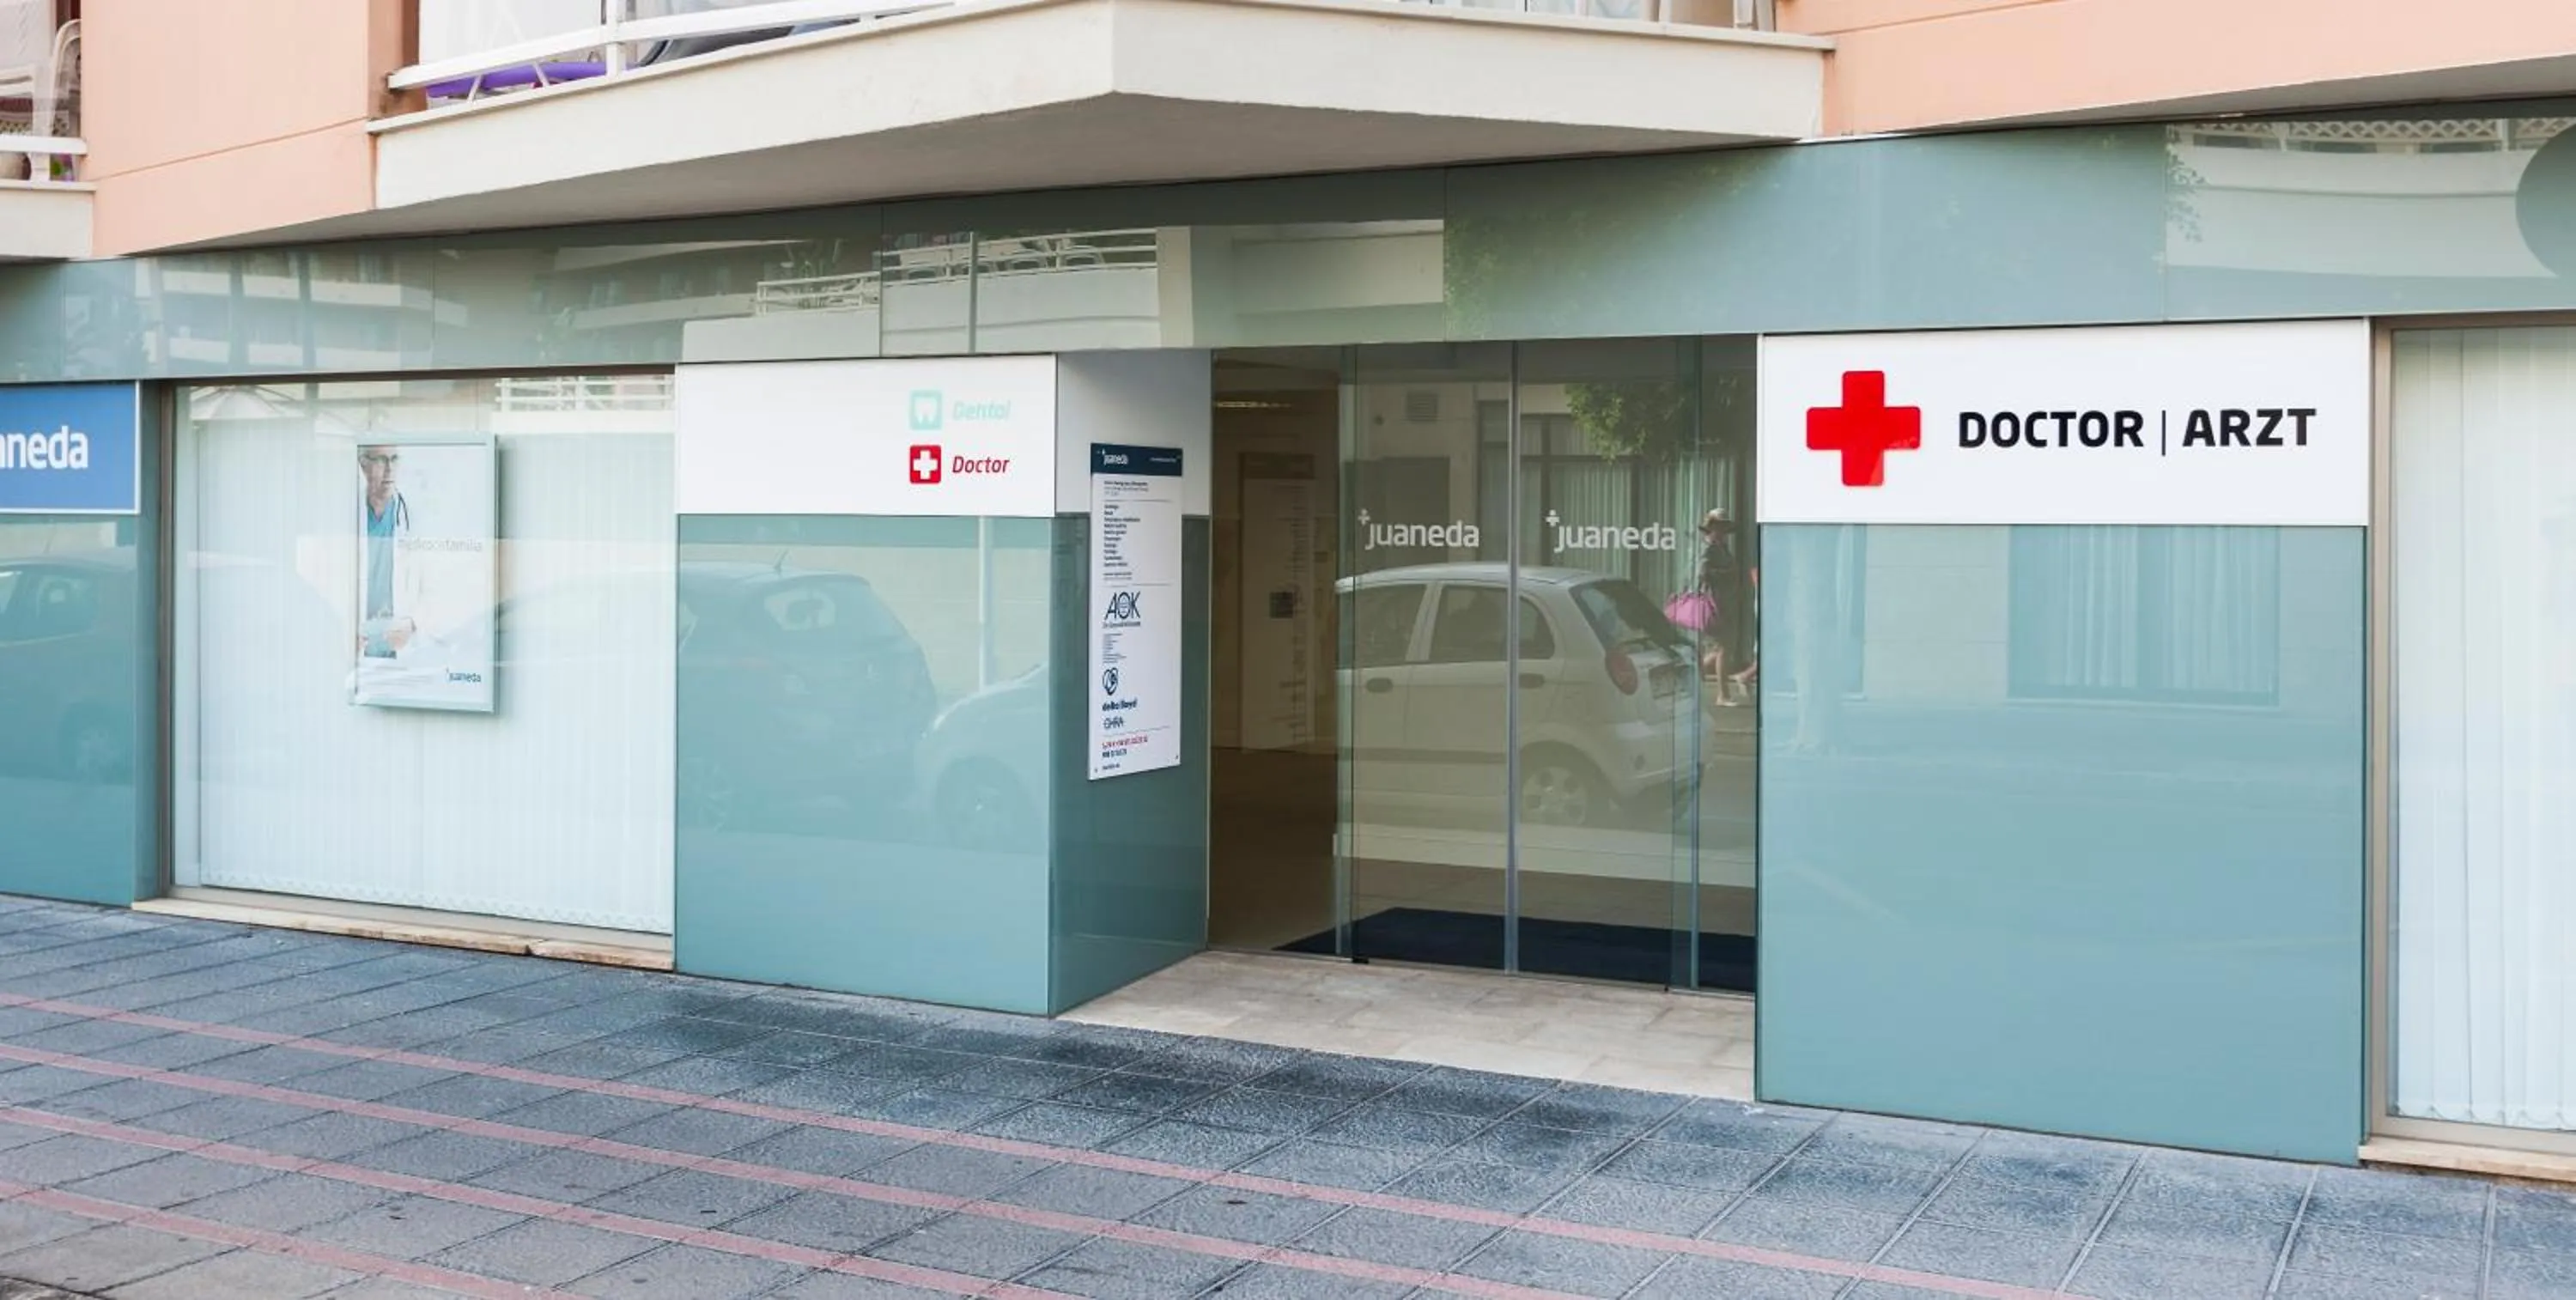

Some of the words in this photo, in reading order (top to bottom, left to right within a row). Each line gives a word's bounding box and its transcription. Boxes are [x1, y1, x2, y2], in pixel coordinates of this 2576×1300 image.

[952, 399, 1011, 421] Dental
[1959, 410, 2144, 448] DOCTOR
[2182, 407, 2318, 447] ARZT
[0, 425, 88, 470] neda
[952, 455, 1010, 474] Doctor
[1364, 519, 1480, 551] juaneda
[1553, 521, 1676, 554] juaneda
[1103, 590, 1141, 621] AOK
